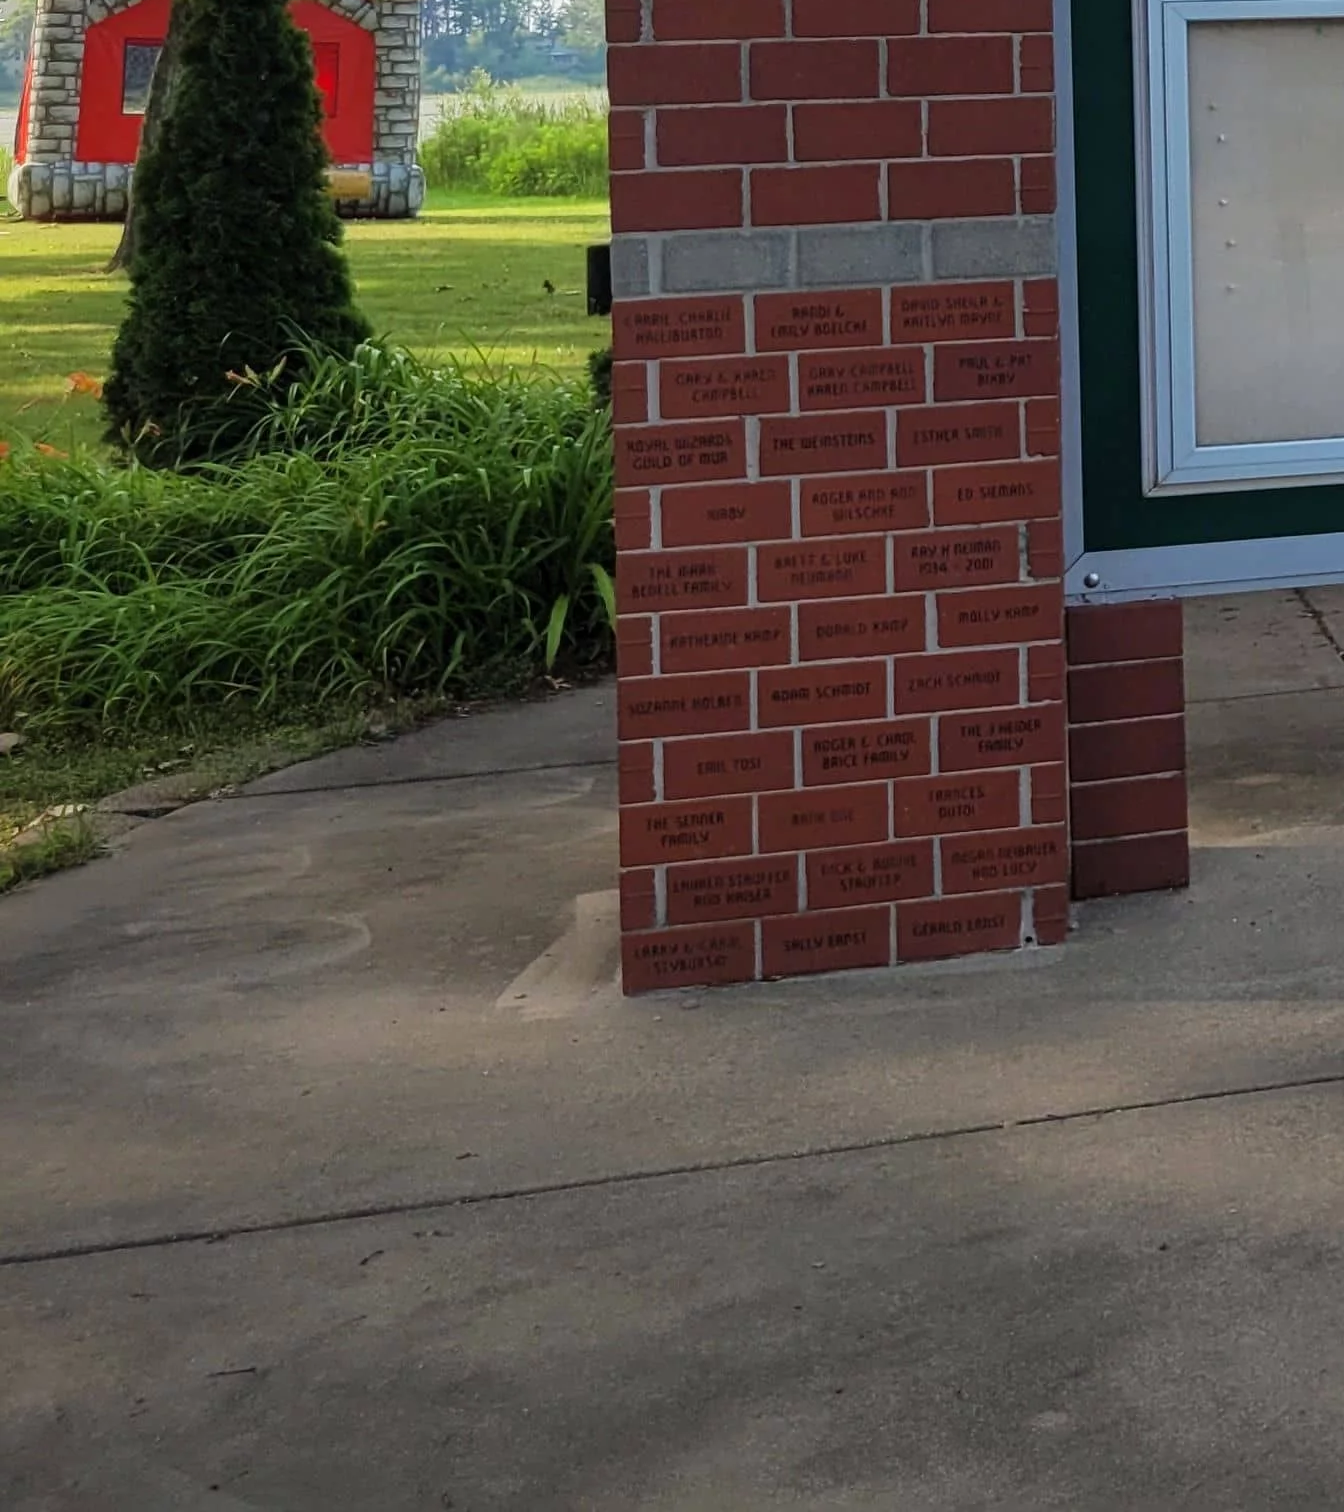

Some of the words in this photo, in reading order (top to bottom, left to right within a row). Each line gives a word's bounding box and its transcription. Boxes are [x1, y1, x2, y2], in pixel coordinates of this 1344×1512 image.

[849, 360, 915, 377] CAMPBELL
[853, 377, 916, 394] CAMPBELL
[772, 437, 795, 451] THE
[800, 432, 876, 449] WEINSTEINS
[631, 454, 673, 470] GUILD
[677, 452, 694, 467] OF
[811, 490, 855, 506] ROGER
[857, 487, 886, 502] AND
[910, 544, 937, 559] RAY
[648, 564, 672, 580] THE
[964, 557, 993, 571] 2001
[682, 576, 733, 595] FAMILY
[958, 607, 1000, 624] MOLLY
[1004, 604, 1040, 620] KAMP
[815, 681, 871, 699] SCHMIDT
[960, 723, 982, 738] THE
[814, 736, 857, 753] ROGER
[977, 735, 1024, 754] FAMILY
[862, 748, 910, 766] FAMILY
[645, 816, 668, 832] THE
[659, 829, 711, 849] FAMILY
